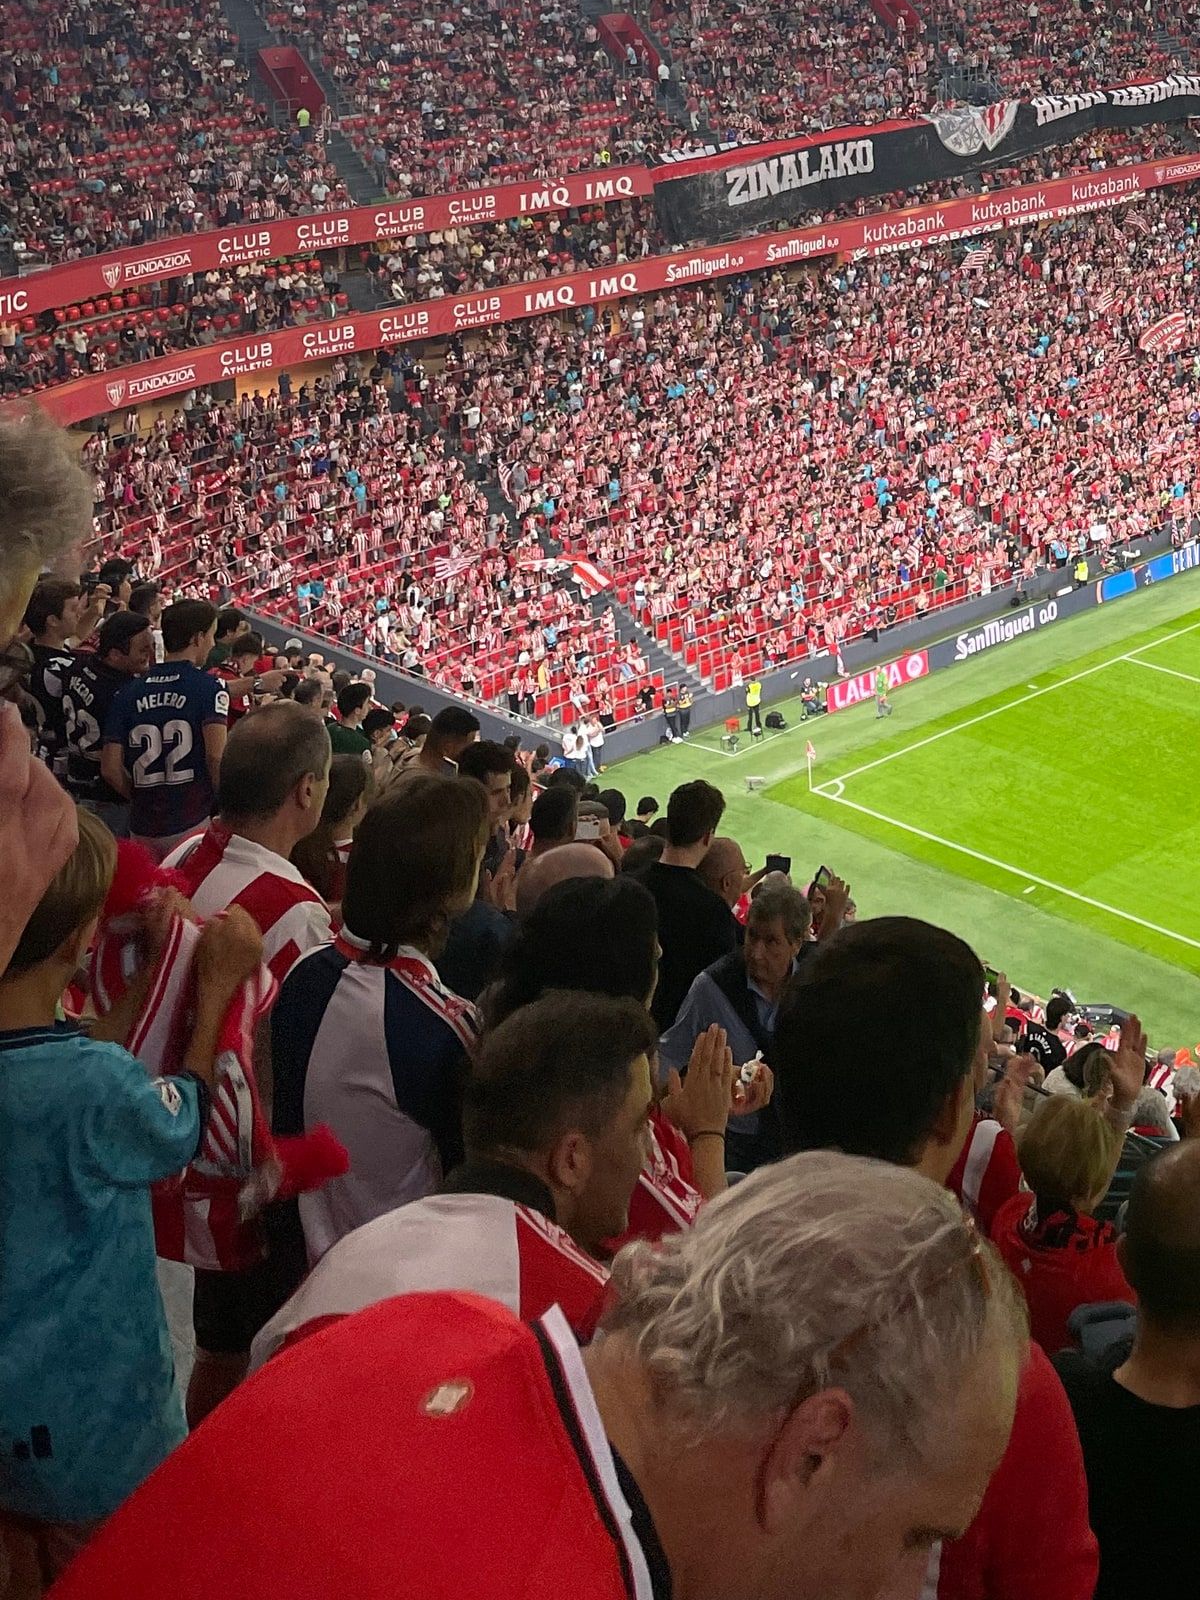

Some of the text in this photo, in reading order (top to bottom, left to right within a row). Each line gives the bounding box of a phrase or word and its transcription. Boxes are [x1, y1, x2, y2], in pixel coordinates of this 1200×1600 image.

[726, 138, 875, 207] ZINALAKO
[586, 176, 635, 200] IMQ
[1071, 172, 1140, 200] kutxabank
[448, 194, 496, 214] CLUB
[520, 186, 571, 212] IMQ
[972, 191, 1046, 221] kutxabank
[374, 206, 424, 227] CLUB
[450, 210, 496, 224] ATHLETIC
[863, 212, 945, 244] kutxabank
[928, 222, 1004, 244] CABACAS
[1009, 210, 1054, 226] HERRI
[1057, 194, 1131, 217] HARMAILA
[297, 218, 350, 240] CLUB
[376, 222, 424, 237] ATHLETIC
[218, 231, 271, 254] CLUB
[298, 234, 349, 250] ATHLETIC
[766, 235, 826, 262] SanMiguel
[125, 253, 191, 278] FUNDAZIOA
[219, 248, 271, 264] ATHLETIC
[664, 253, 730, 282] SanMiguel
[590, 272, 638, 298] IMQ
[454, 296, 500, 318] CLUB
[525, 286, 576, 312] IMQ
[379, 311, 429, 332] CLUB
[454, 312, 500, 328] ATHLETIC
[302, 325, 355, 348] CLUB
[380, 327, 428, 343] ATHLETIC
[220, 342, 273, 366] CLUB
[304, 341, 355, 358] ATHLETIC
[221, 358, 273, 377] ATHLETIC
[129, 368, 196, 396] FUNDAZIOA
[954, 608, 1034, 660] SanMiguel
[834, 662, 902, 709] LALIA
[136, 690, 187, 713] MELERO
[129, 719, 194, 788] 22
